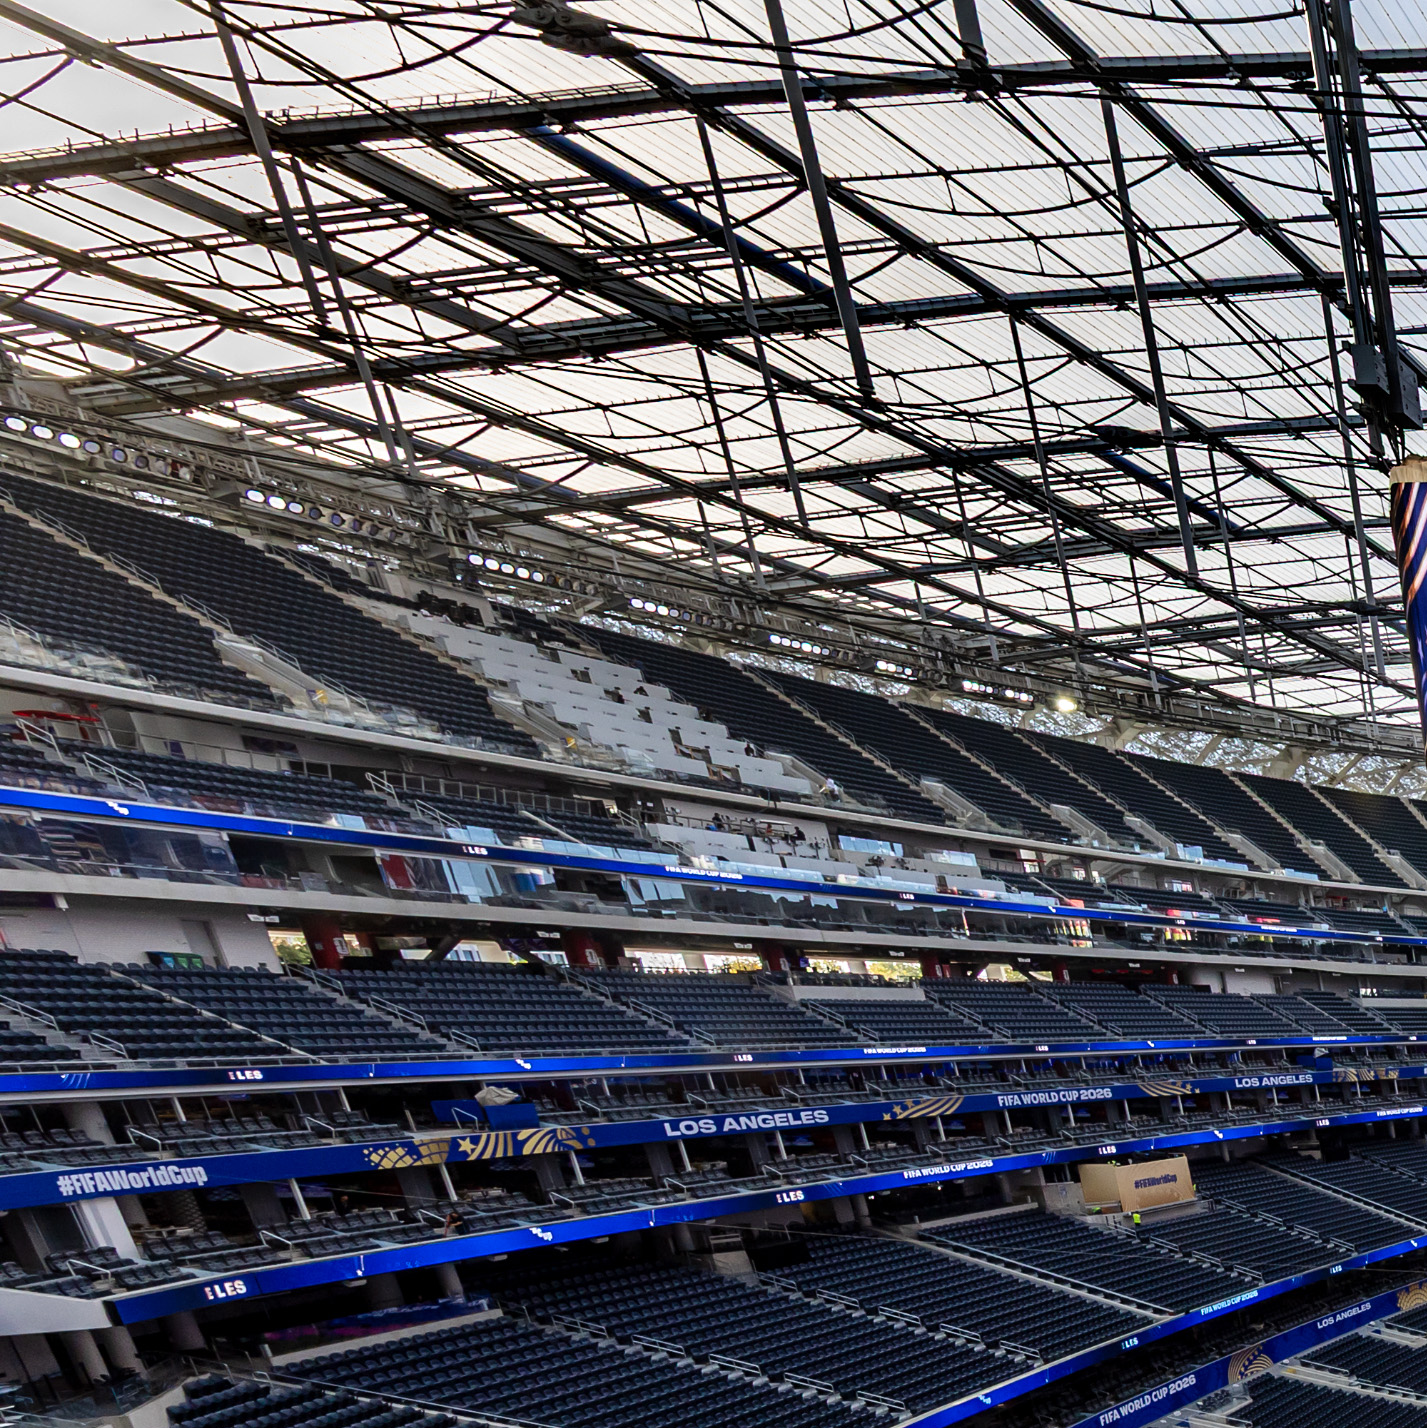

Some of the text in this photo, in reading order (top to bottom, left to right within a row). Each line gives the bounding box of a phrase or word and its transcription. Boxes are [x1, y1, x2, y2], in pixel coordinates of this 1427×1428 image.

[1234, 1074, 1313, 1087] LOS ANGELES
[997, 1088, 1112, 1107] FIFA WORLD CUP 2026
[663, 1110, 829, 1136] LOS ANGELES
[57, 1165, 208, 1196] #FIFAWorldCup
[903, 1160, 994, 1179] FIFA WORLD CUP 2026
[1317, 1302, 1371, 1329] LOS ANGELES
[1100, 1374, 1196, 1426] FIFA WORLD CUP 2026
